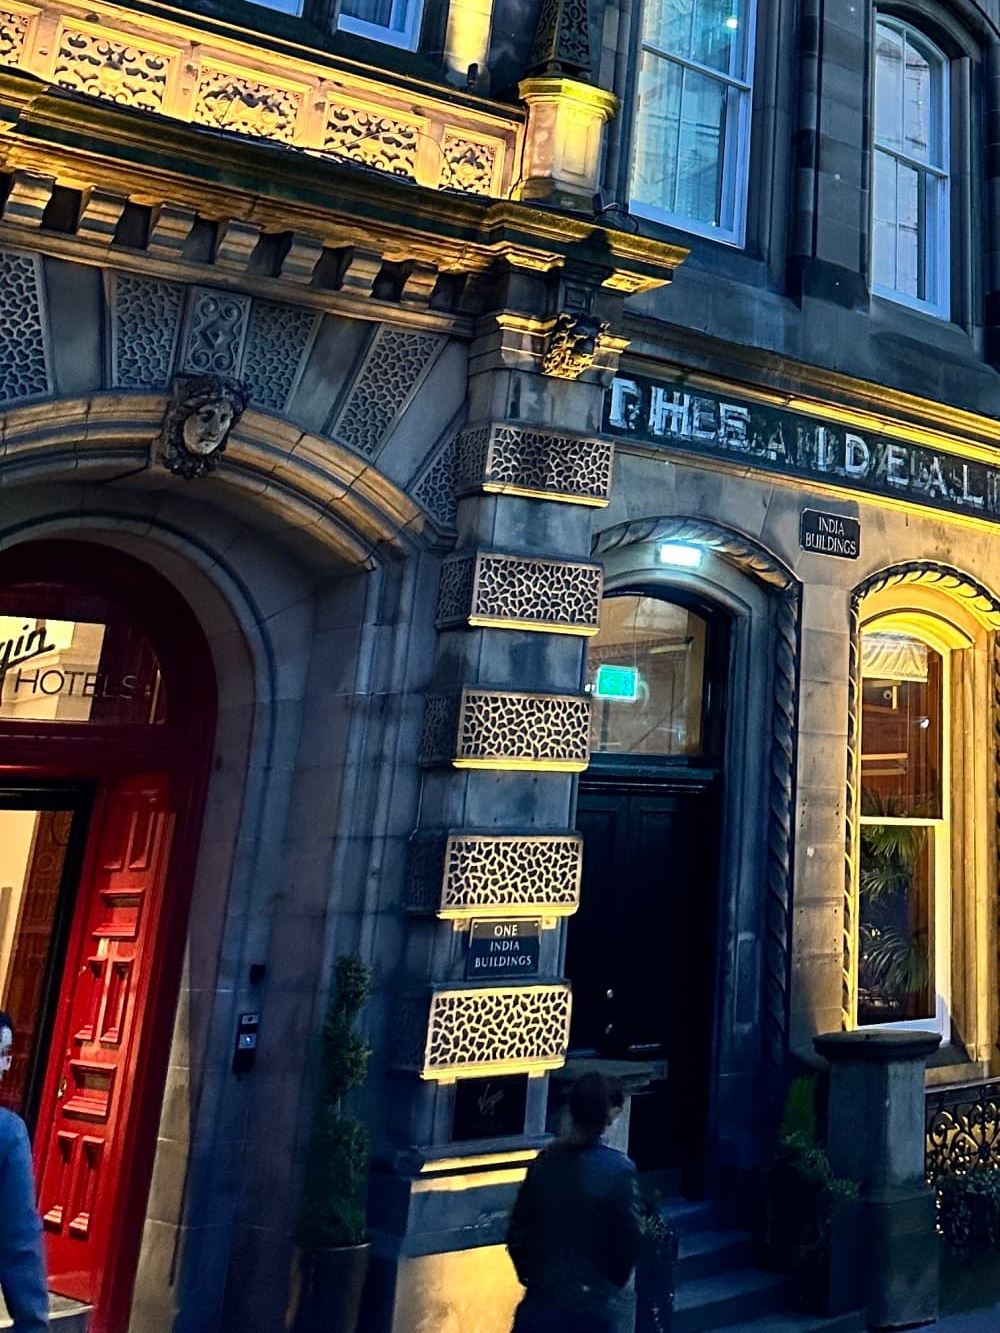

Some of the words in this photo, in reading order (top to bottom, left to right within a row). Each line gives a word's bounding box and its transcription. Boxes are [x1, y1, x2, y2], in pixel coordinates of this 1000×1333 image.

[818, 516, 845, 536] INDIA
[805, 532, 857, 555] BUILDINGS
[14, 668, 138, 698] HOTELS
[494, 924, 519, 937] ONE
[490, 940, 520, 952] INDIA
[475, 955, 532, 968] BUILDINGS
